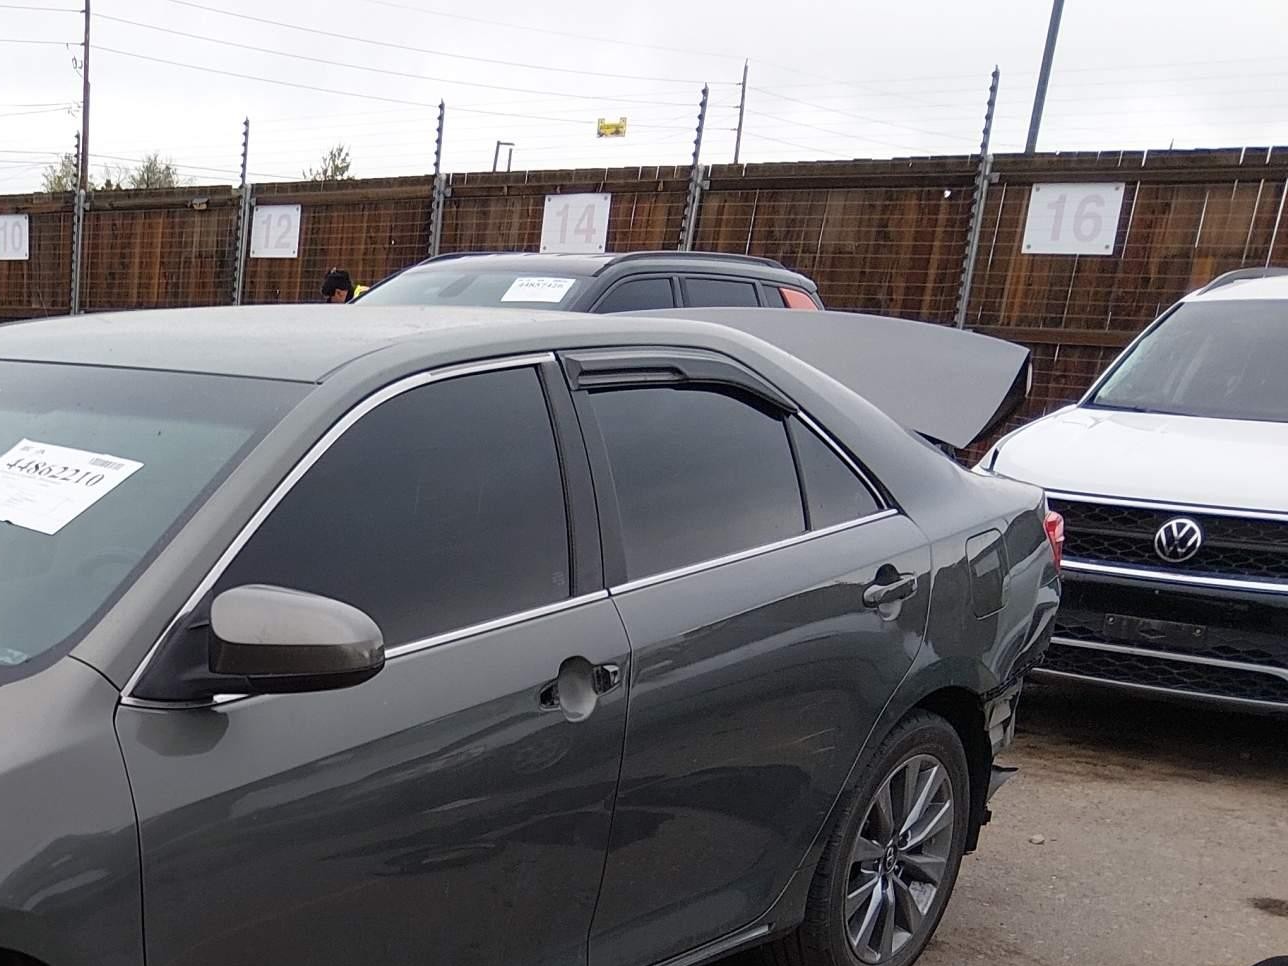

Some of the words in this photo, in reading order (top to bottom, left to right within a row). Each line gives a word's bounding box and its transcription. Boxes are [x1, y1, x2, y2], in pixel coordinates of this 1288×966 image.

[262, 214, 293, 249] 12
[556, 204, 597, 244] 14
[1047, 193, 1106, 243] 16
[0, 221, 23, 252] 10
[6, 458, 105, 487] 44862210
